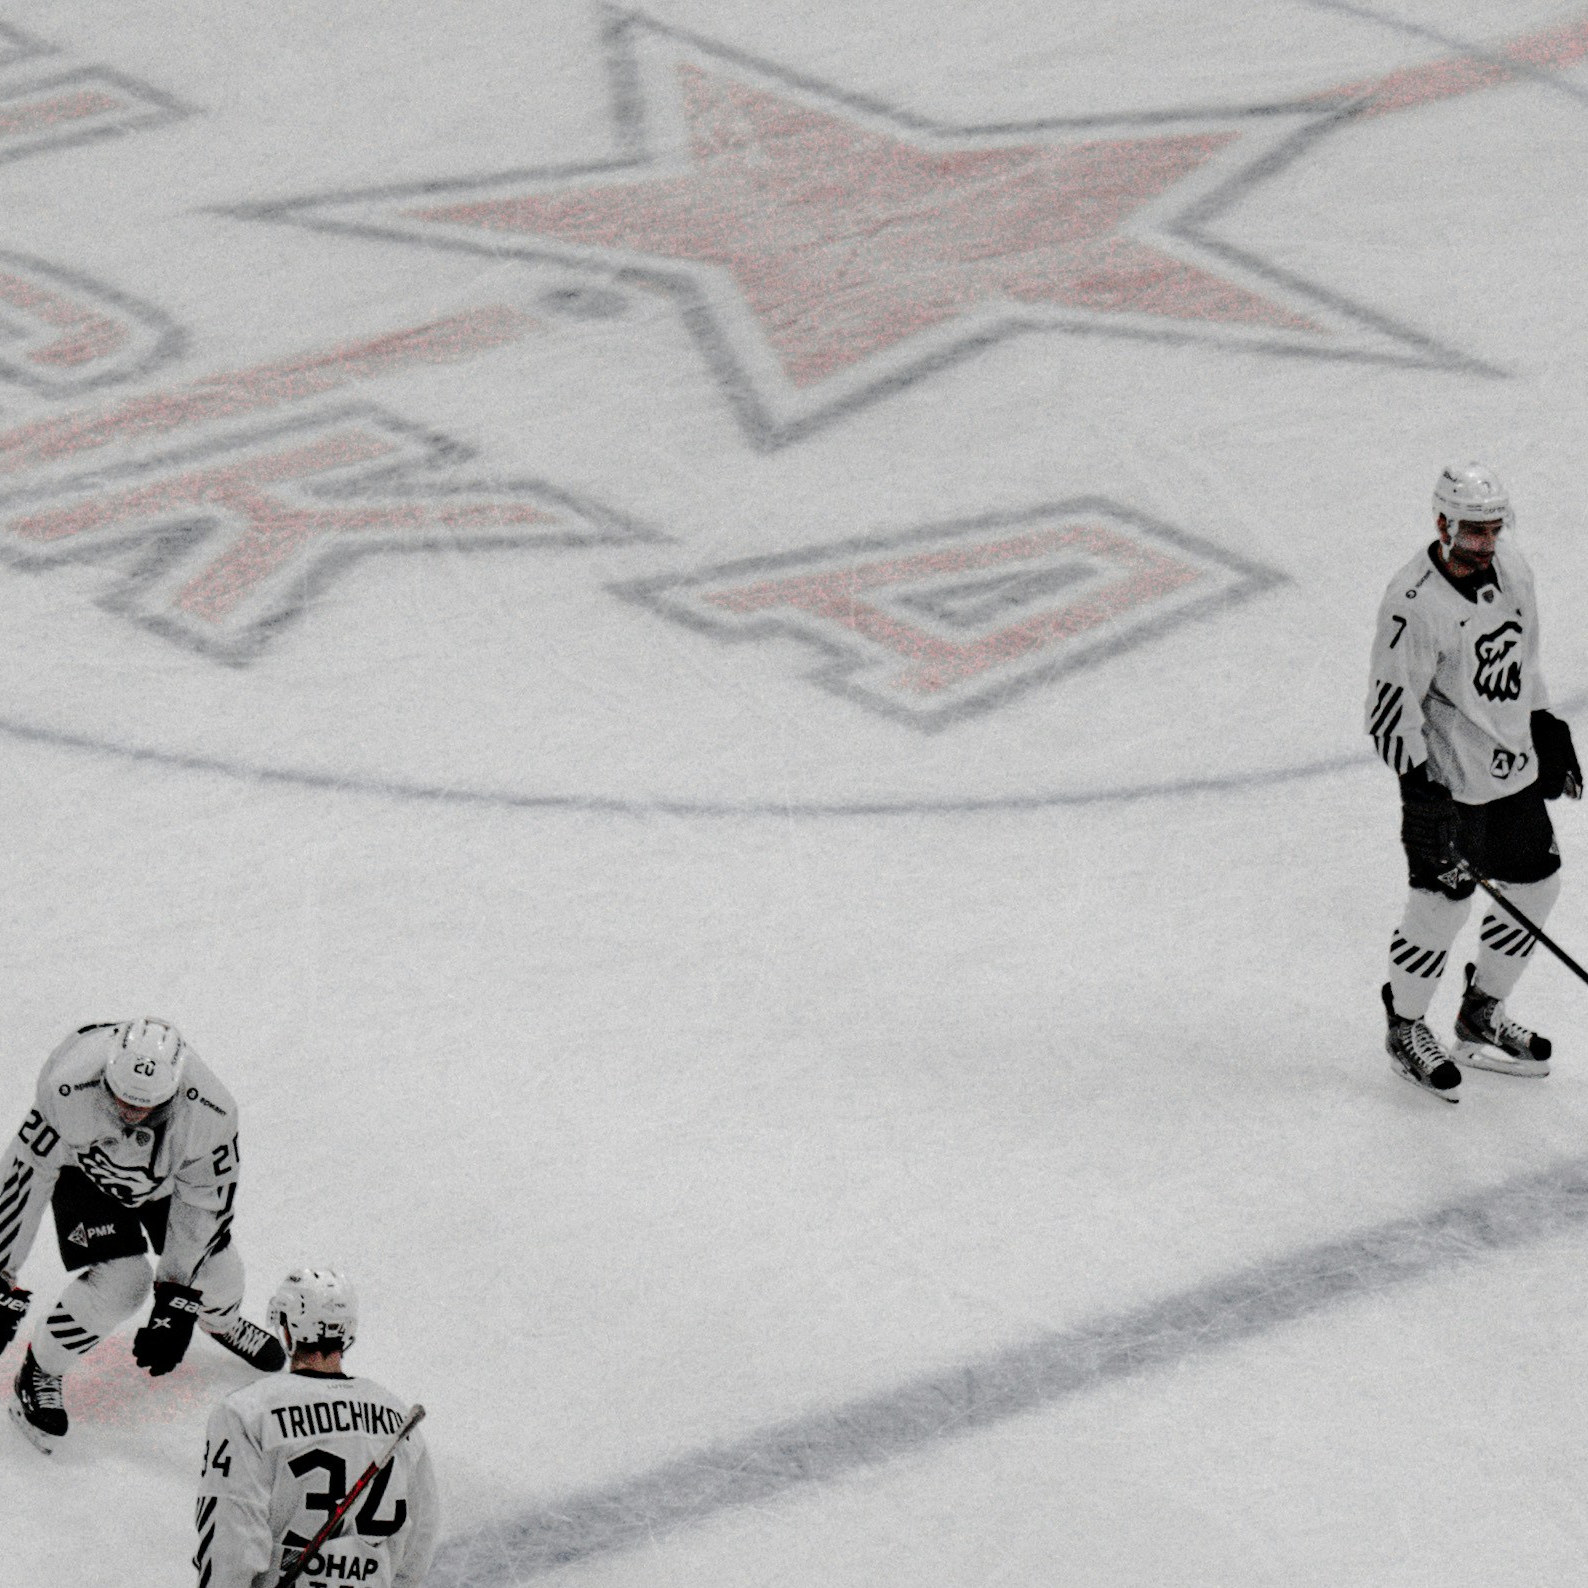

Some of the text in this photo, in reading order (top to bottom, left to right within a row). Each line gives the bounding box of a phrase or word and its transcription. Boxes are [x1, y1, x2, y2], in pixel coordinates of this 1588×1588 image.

[1390, 614, 1407, 650] 7
[134, 1058, 156, 1077] 20
[17, 1108, 61, 1158] 20
[281, 1448, 408, 1547] 34
